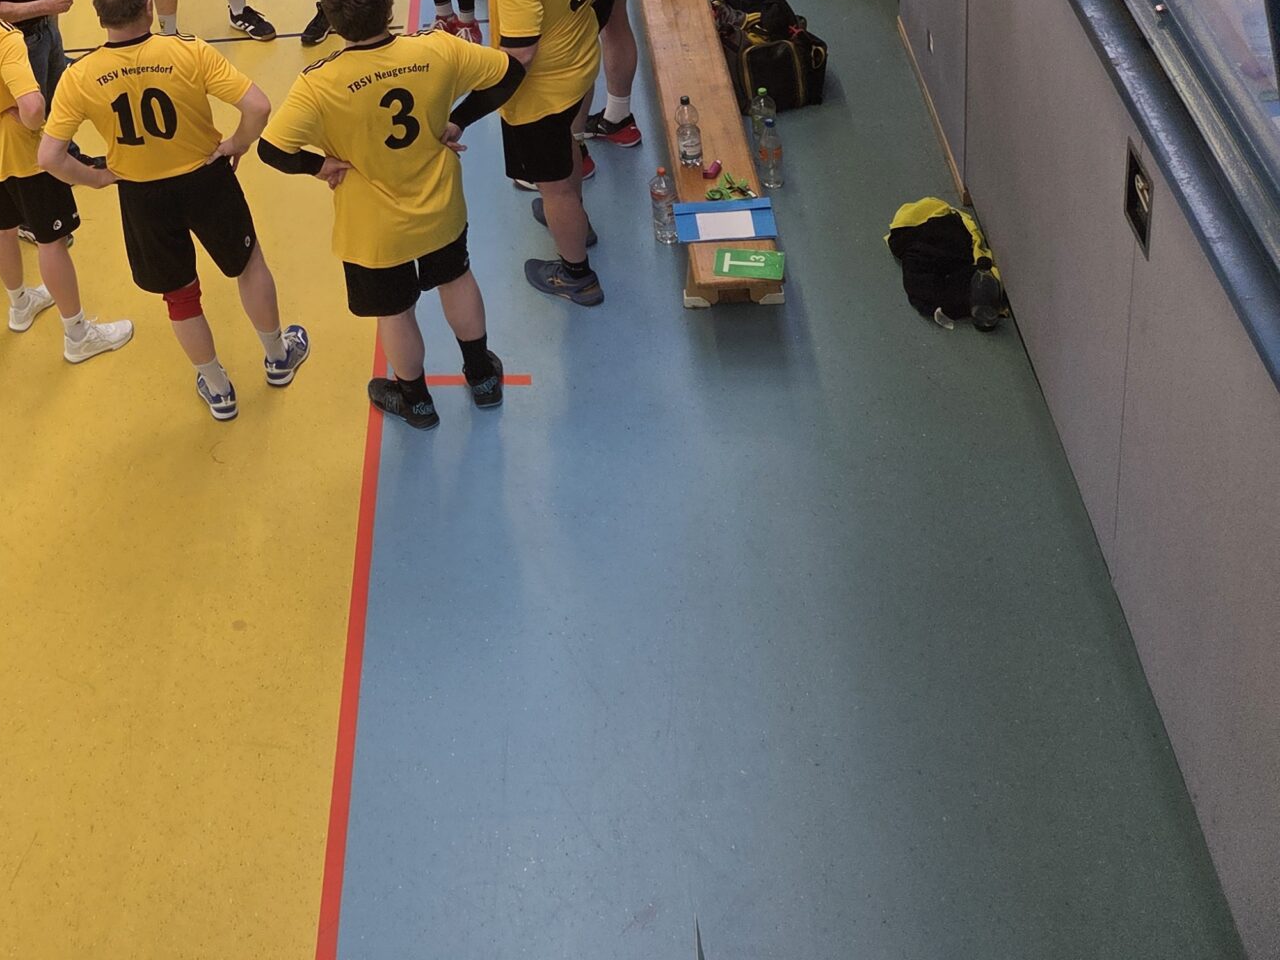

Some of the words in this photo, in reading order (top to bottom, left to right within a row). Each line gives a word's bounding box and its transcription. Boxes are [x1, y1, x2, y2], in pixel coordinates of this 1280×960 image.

[97, 70, 119, 86] TBSV
[347, 75, 372, 93] TBSV
[374, 63, 430, 81] Neugersdorf
[111, 88, 178, 146] 10
[379, 88, 420, 149] 3
